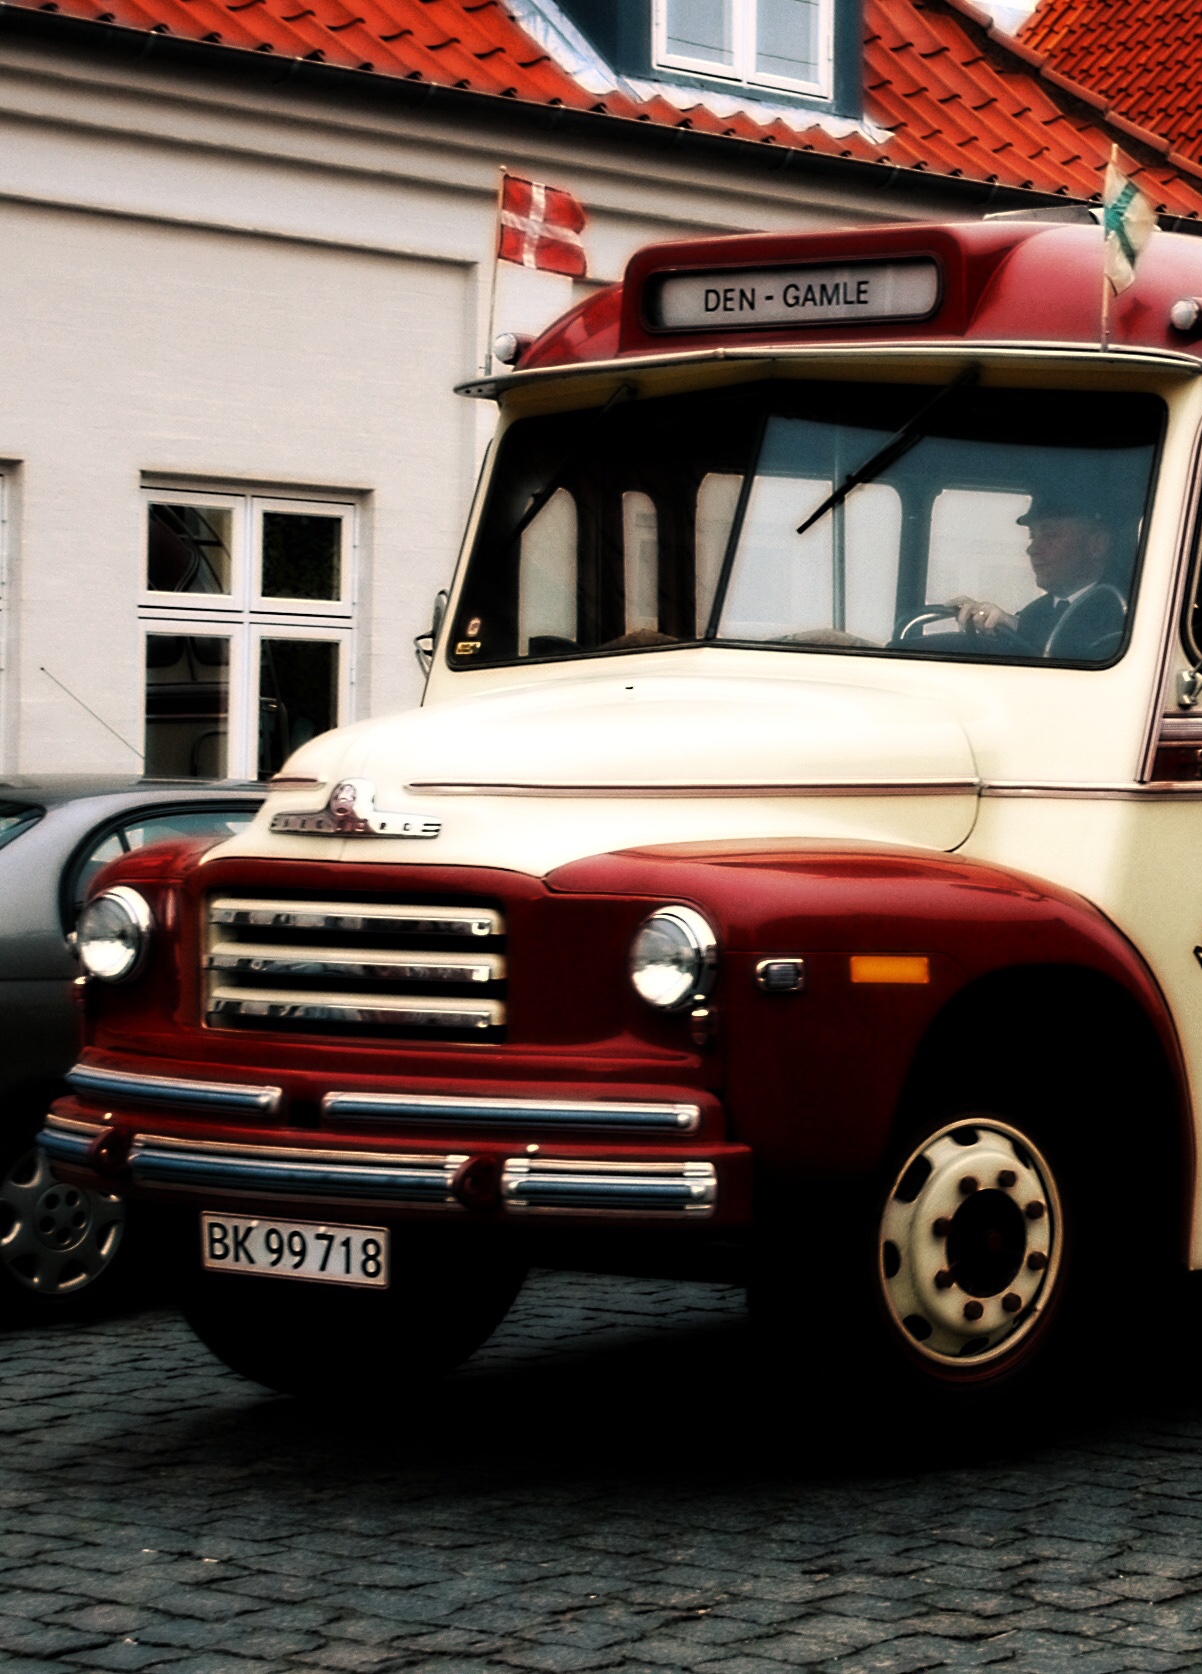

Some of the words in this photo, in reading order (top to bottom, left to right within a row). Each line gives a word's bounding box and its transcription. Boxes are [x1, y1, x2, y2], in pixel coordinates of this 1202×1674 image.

[704, 288, 756, 312] DEN
[782, 280, 870, 308] GAMLE
[208, 1222, 256, 1265] BK
[265, 1228, 307, 1270] 99
[315, 1233, 381, 1278] 718
